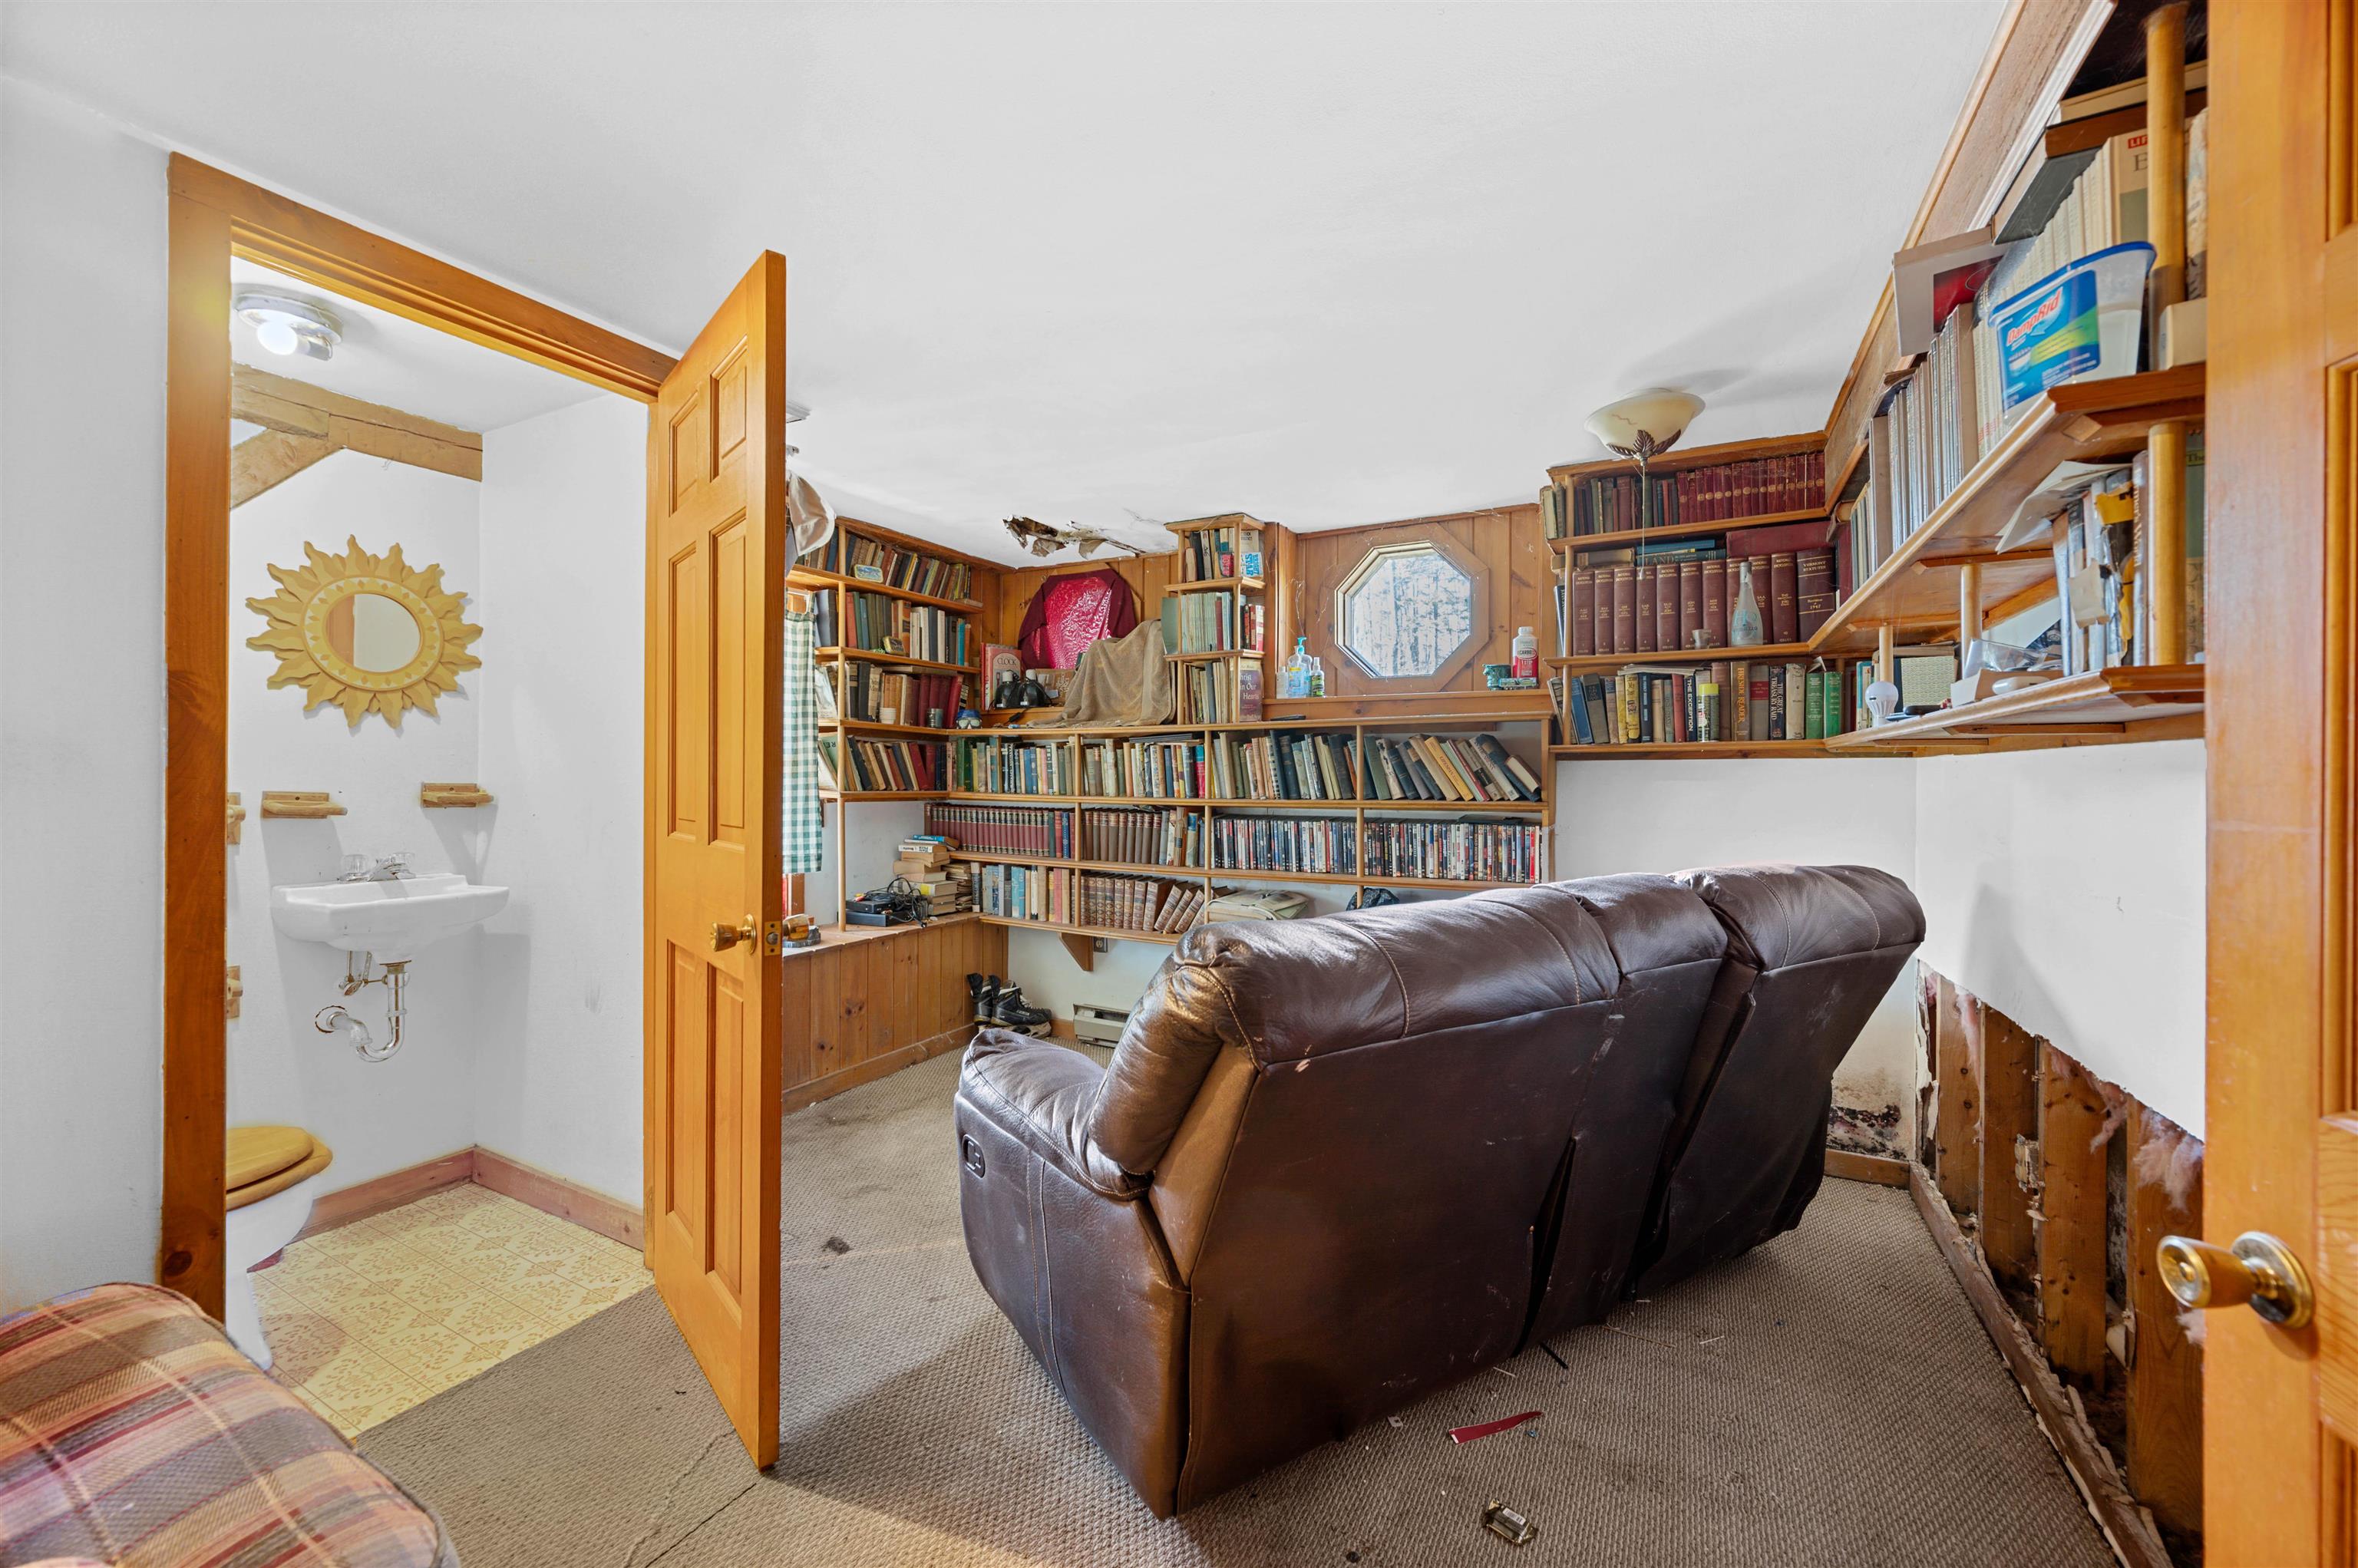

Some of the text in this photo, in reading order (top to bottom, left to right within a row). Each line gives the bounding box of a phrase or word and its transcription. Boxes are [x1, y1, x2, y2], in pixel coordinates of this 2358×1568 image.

[2130, 136, 2148, 147] LIF
[2006, 286, 2063, 347] DampRid
[997, 657, 1016, 665] CLOCK
[1240, 673, 1252, 682] hrist
